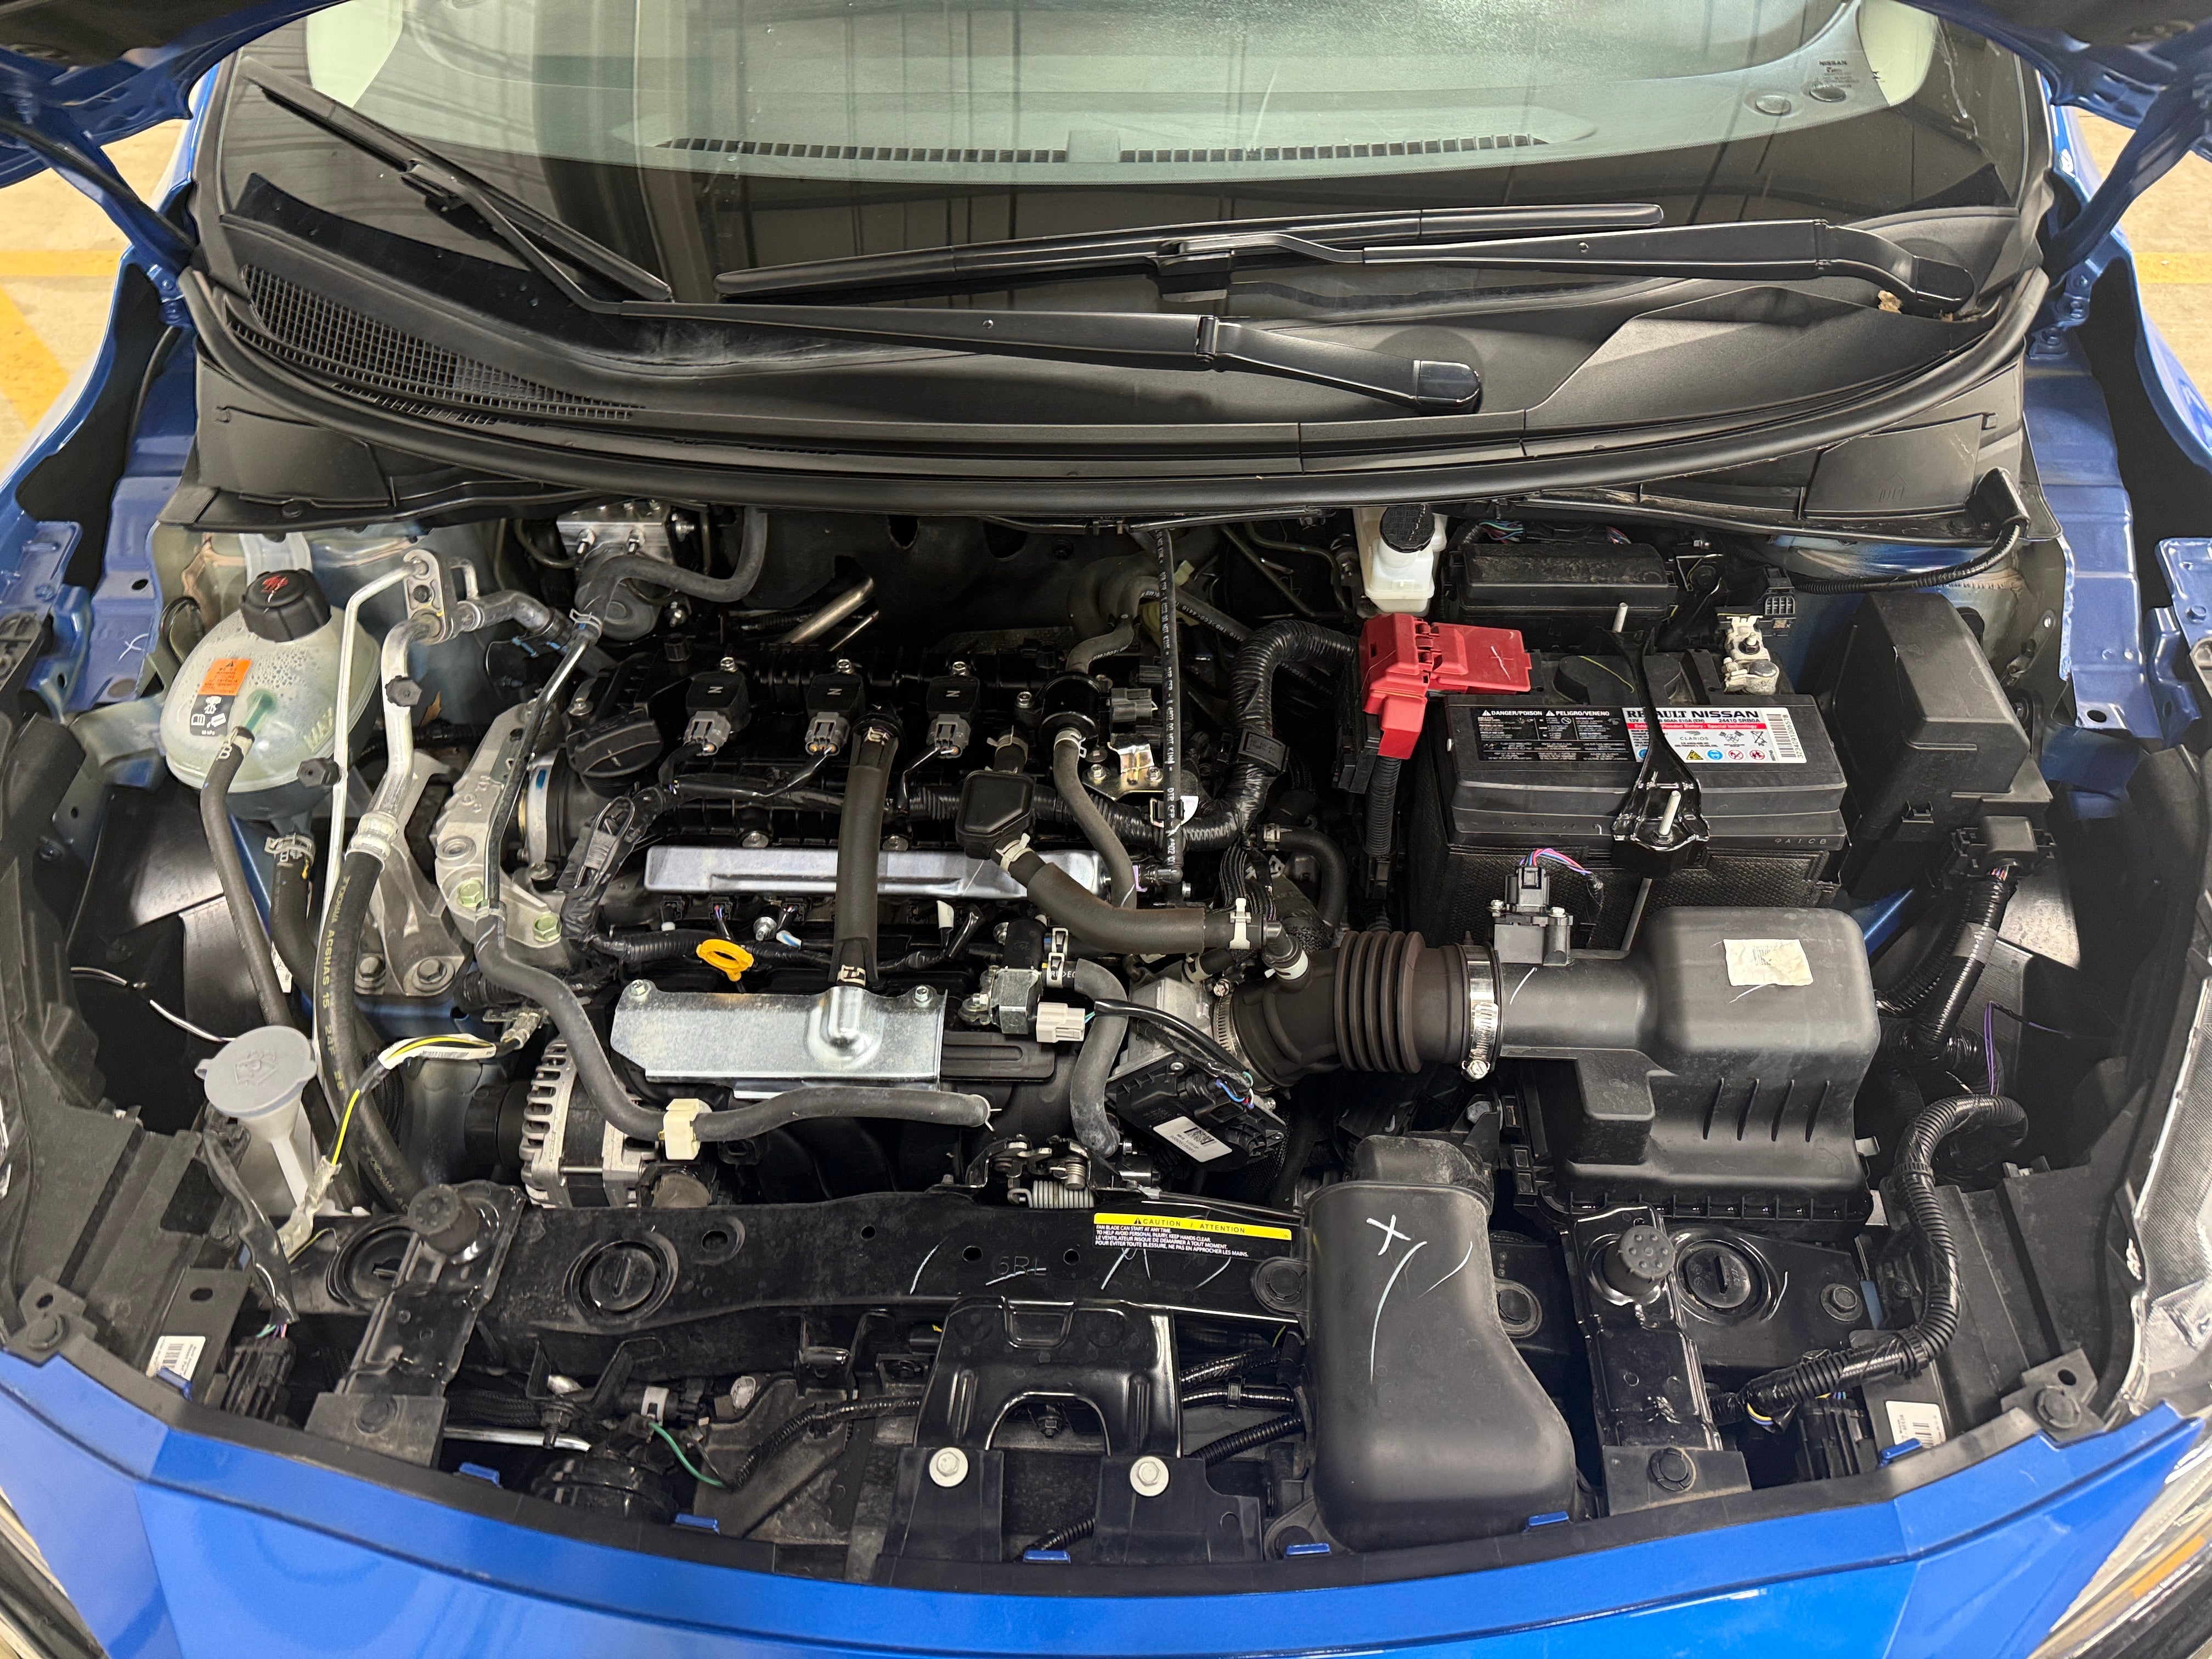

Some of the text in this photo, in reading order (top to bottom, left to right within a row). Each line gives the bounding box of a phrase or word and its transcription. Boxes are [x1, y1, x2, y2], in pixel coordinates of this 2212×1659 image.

[1167, 787, 1175, 802] DTR
[322, 992, 328, 1009] 15
[324, 1025, 336, 1058] 24F
[1143, 1218, 1181, 1227] CAUTION
[1200, 1223, 1245, 1233] ATTENTION
